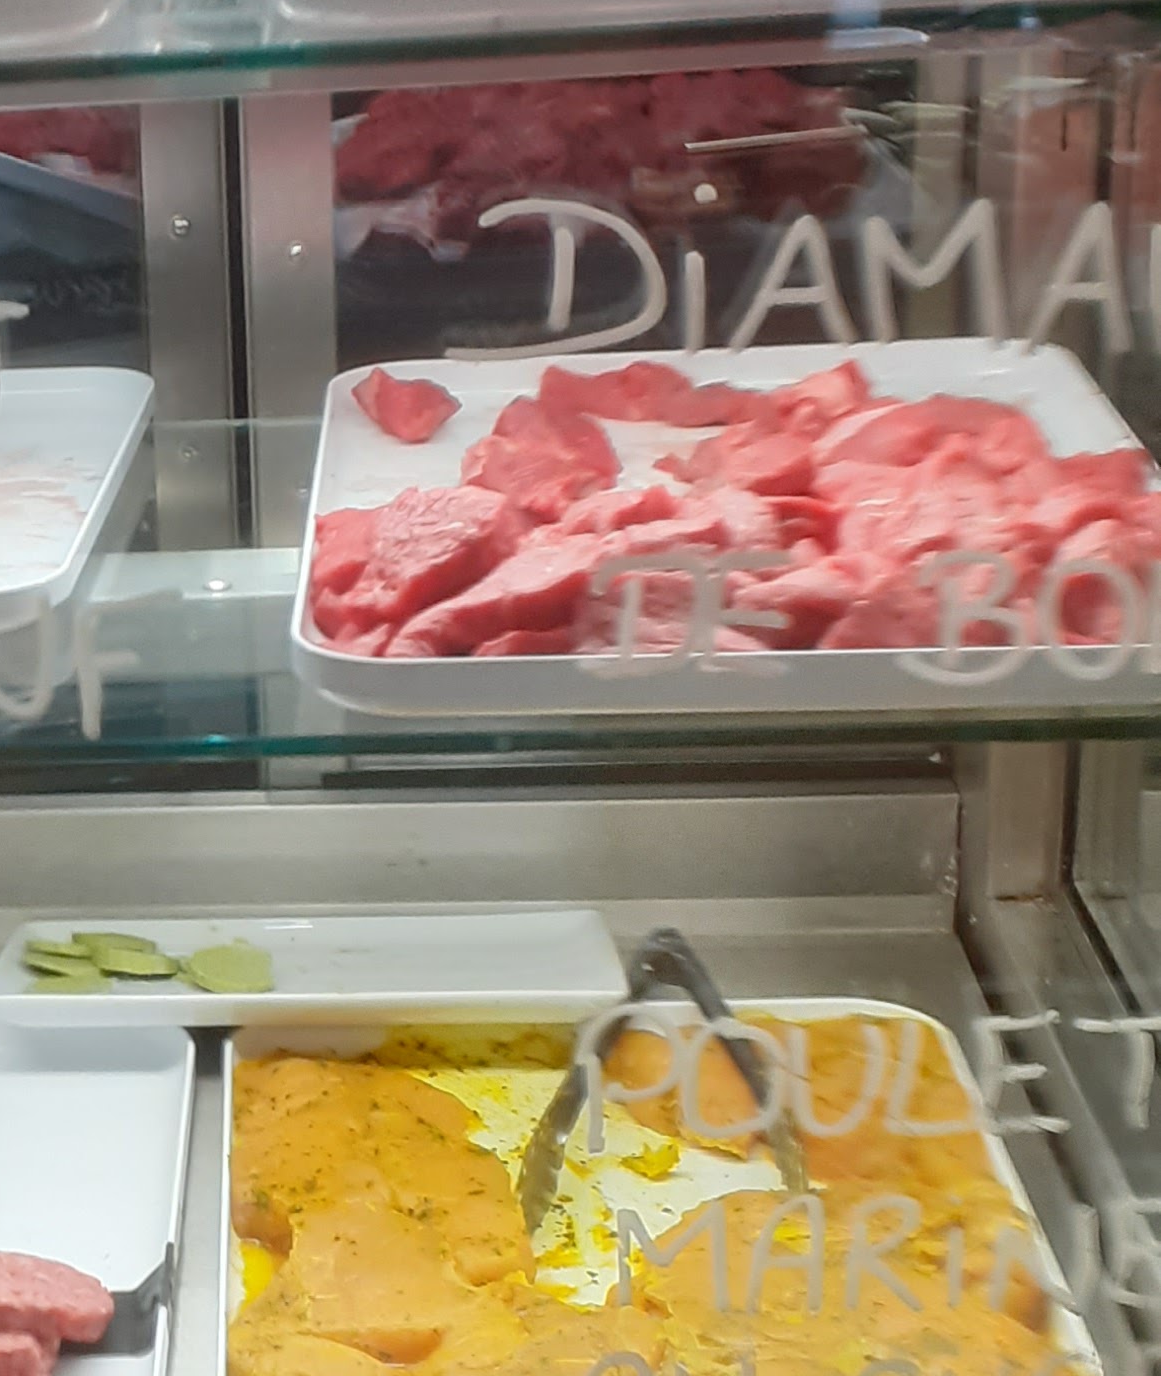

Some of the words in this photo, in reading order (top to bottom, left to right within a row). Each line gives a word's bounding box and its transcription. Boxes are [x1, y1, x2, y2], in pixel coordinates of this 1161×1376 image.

[574, 544, 791, 682] DE
[895, 549, 1161, 686] BO
[573, 1002, 1161, 1154] POULET
